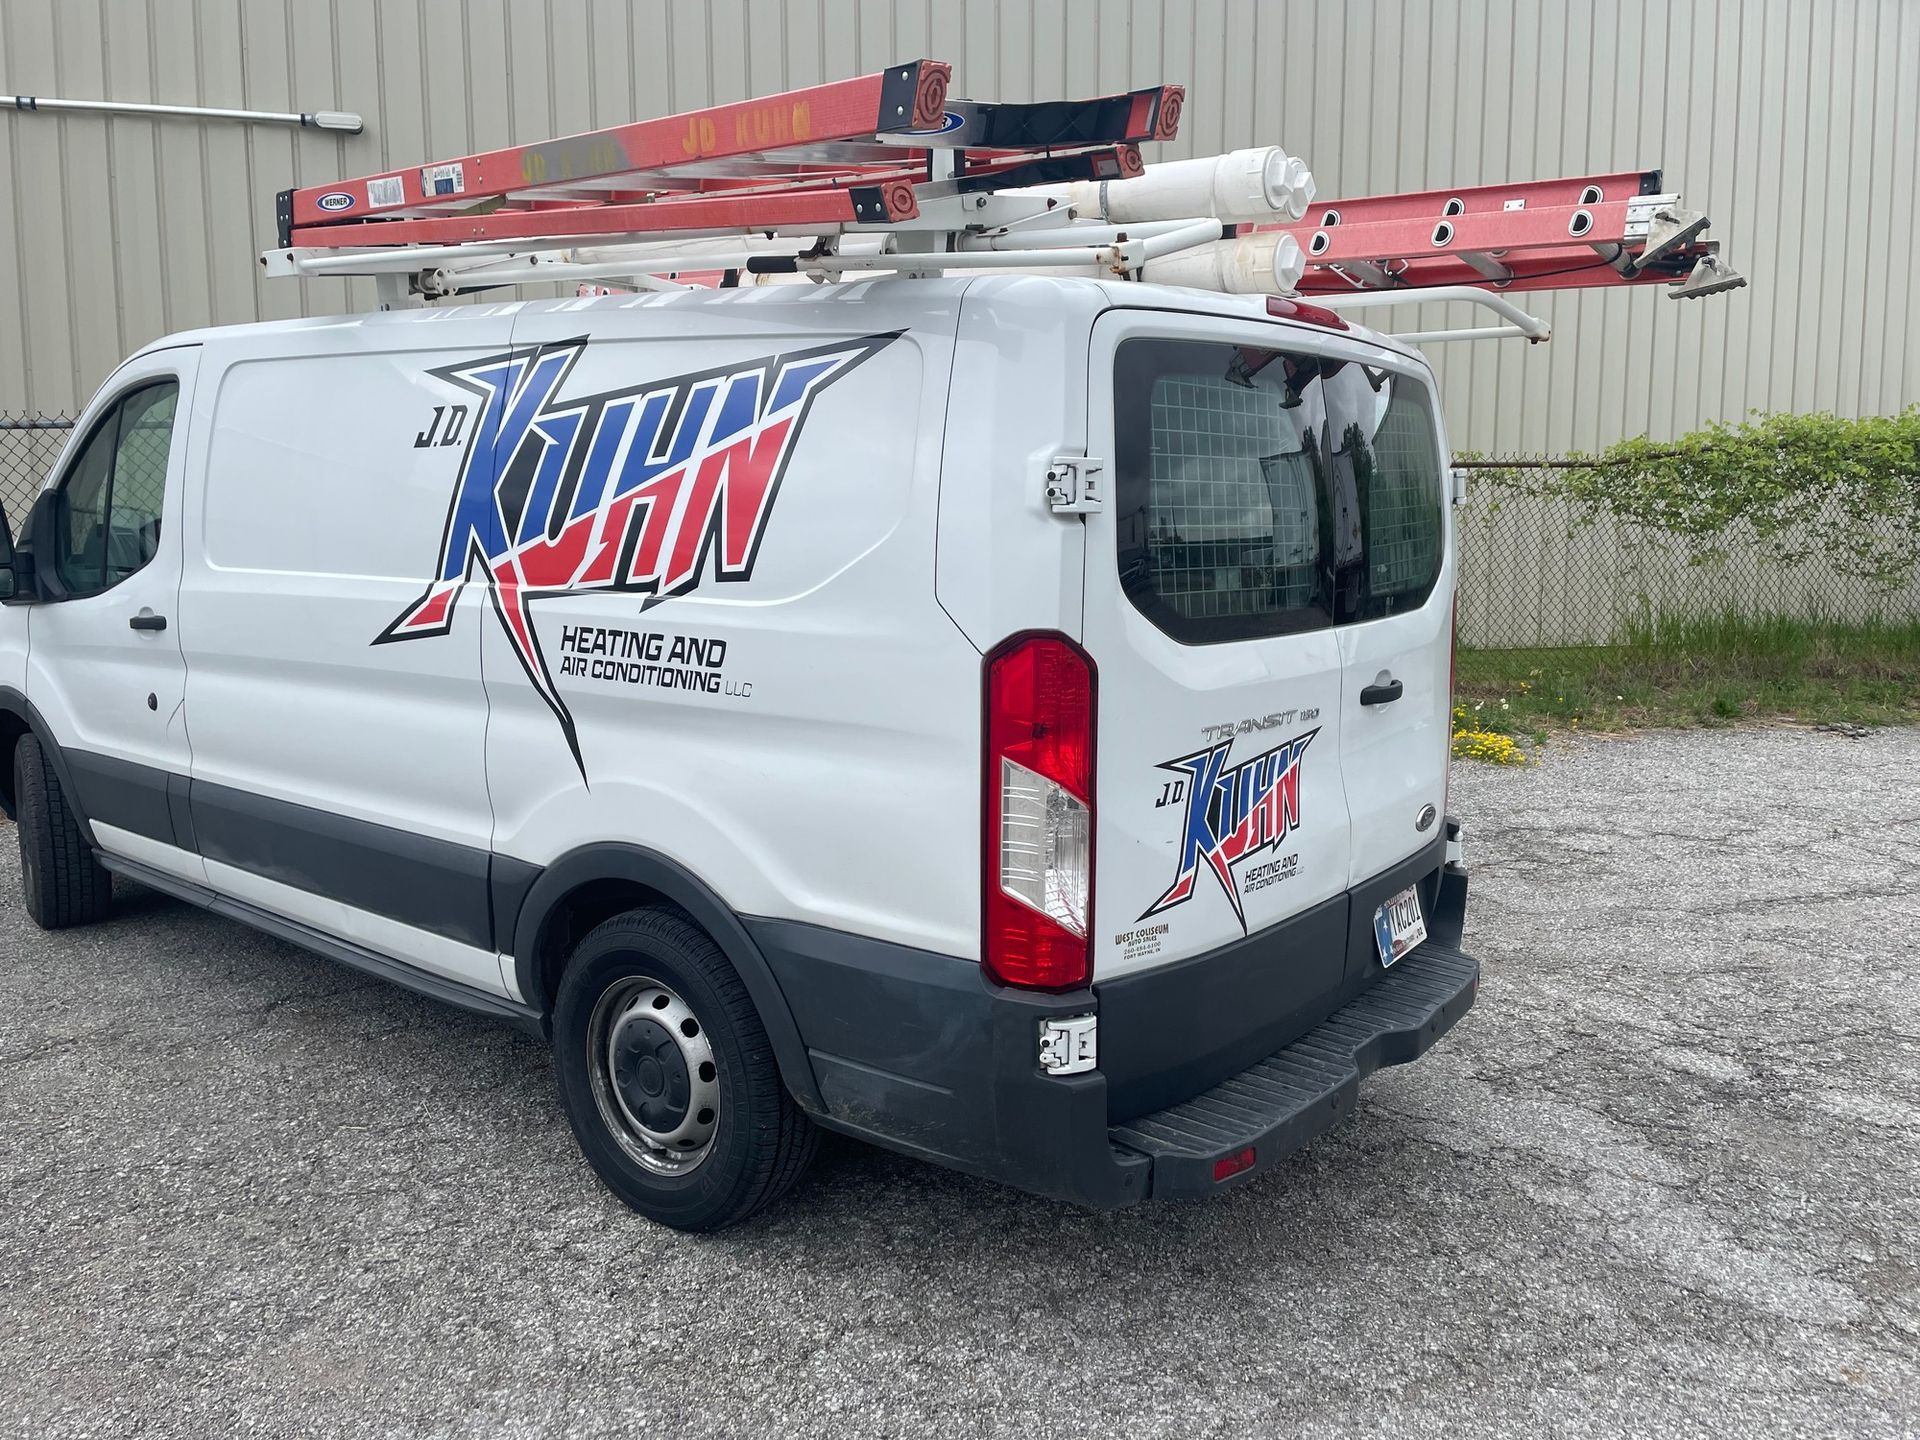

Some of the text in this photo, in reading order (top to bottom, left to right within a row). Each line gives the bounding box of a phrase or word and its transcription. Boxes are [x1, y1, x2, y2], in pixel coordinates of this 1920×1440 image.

[682, 116, 716, 154] JD
[324, 197, 348, 206] WERNER
[369, 328, 911, 792] J.D. KUHN
[560, 625, 727, 668] HEATING AND
[560, 656, 753, 698] AIR CONDITIONING LLC
[1201, 708, 1299, 743] TRANSIT
[1134, 725, 1322, 937] J.D. KUHN
[1243, 882, 1256, 894] AIR
[1255, 867, 1297, 891] CONDITIONING
[1244, 852, 1299, 884] HEATING AND
[1115, 923, 1169, 945] WEST COLISEUM
[1127, 935, 1157, 948] AUTO SALES
